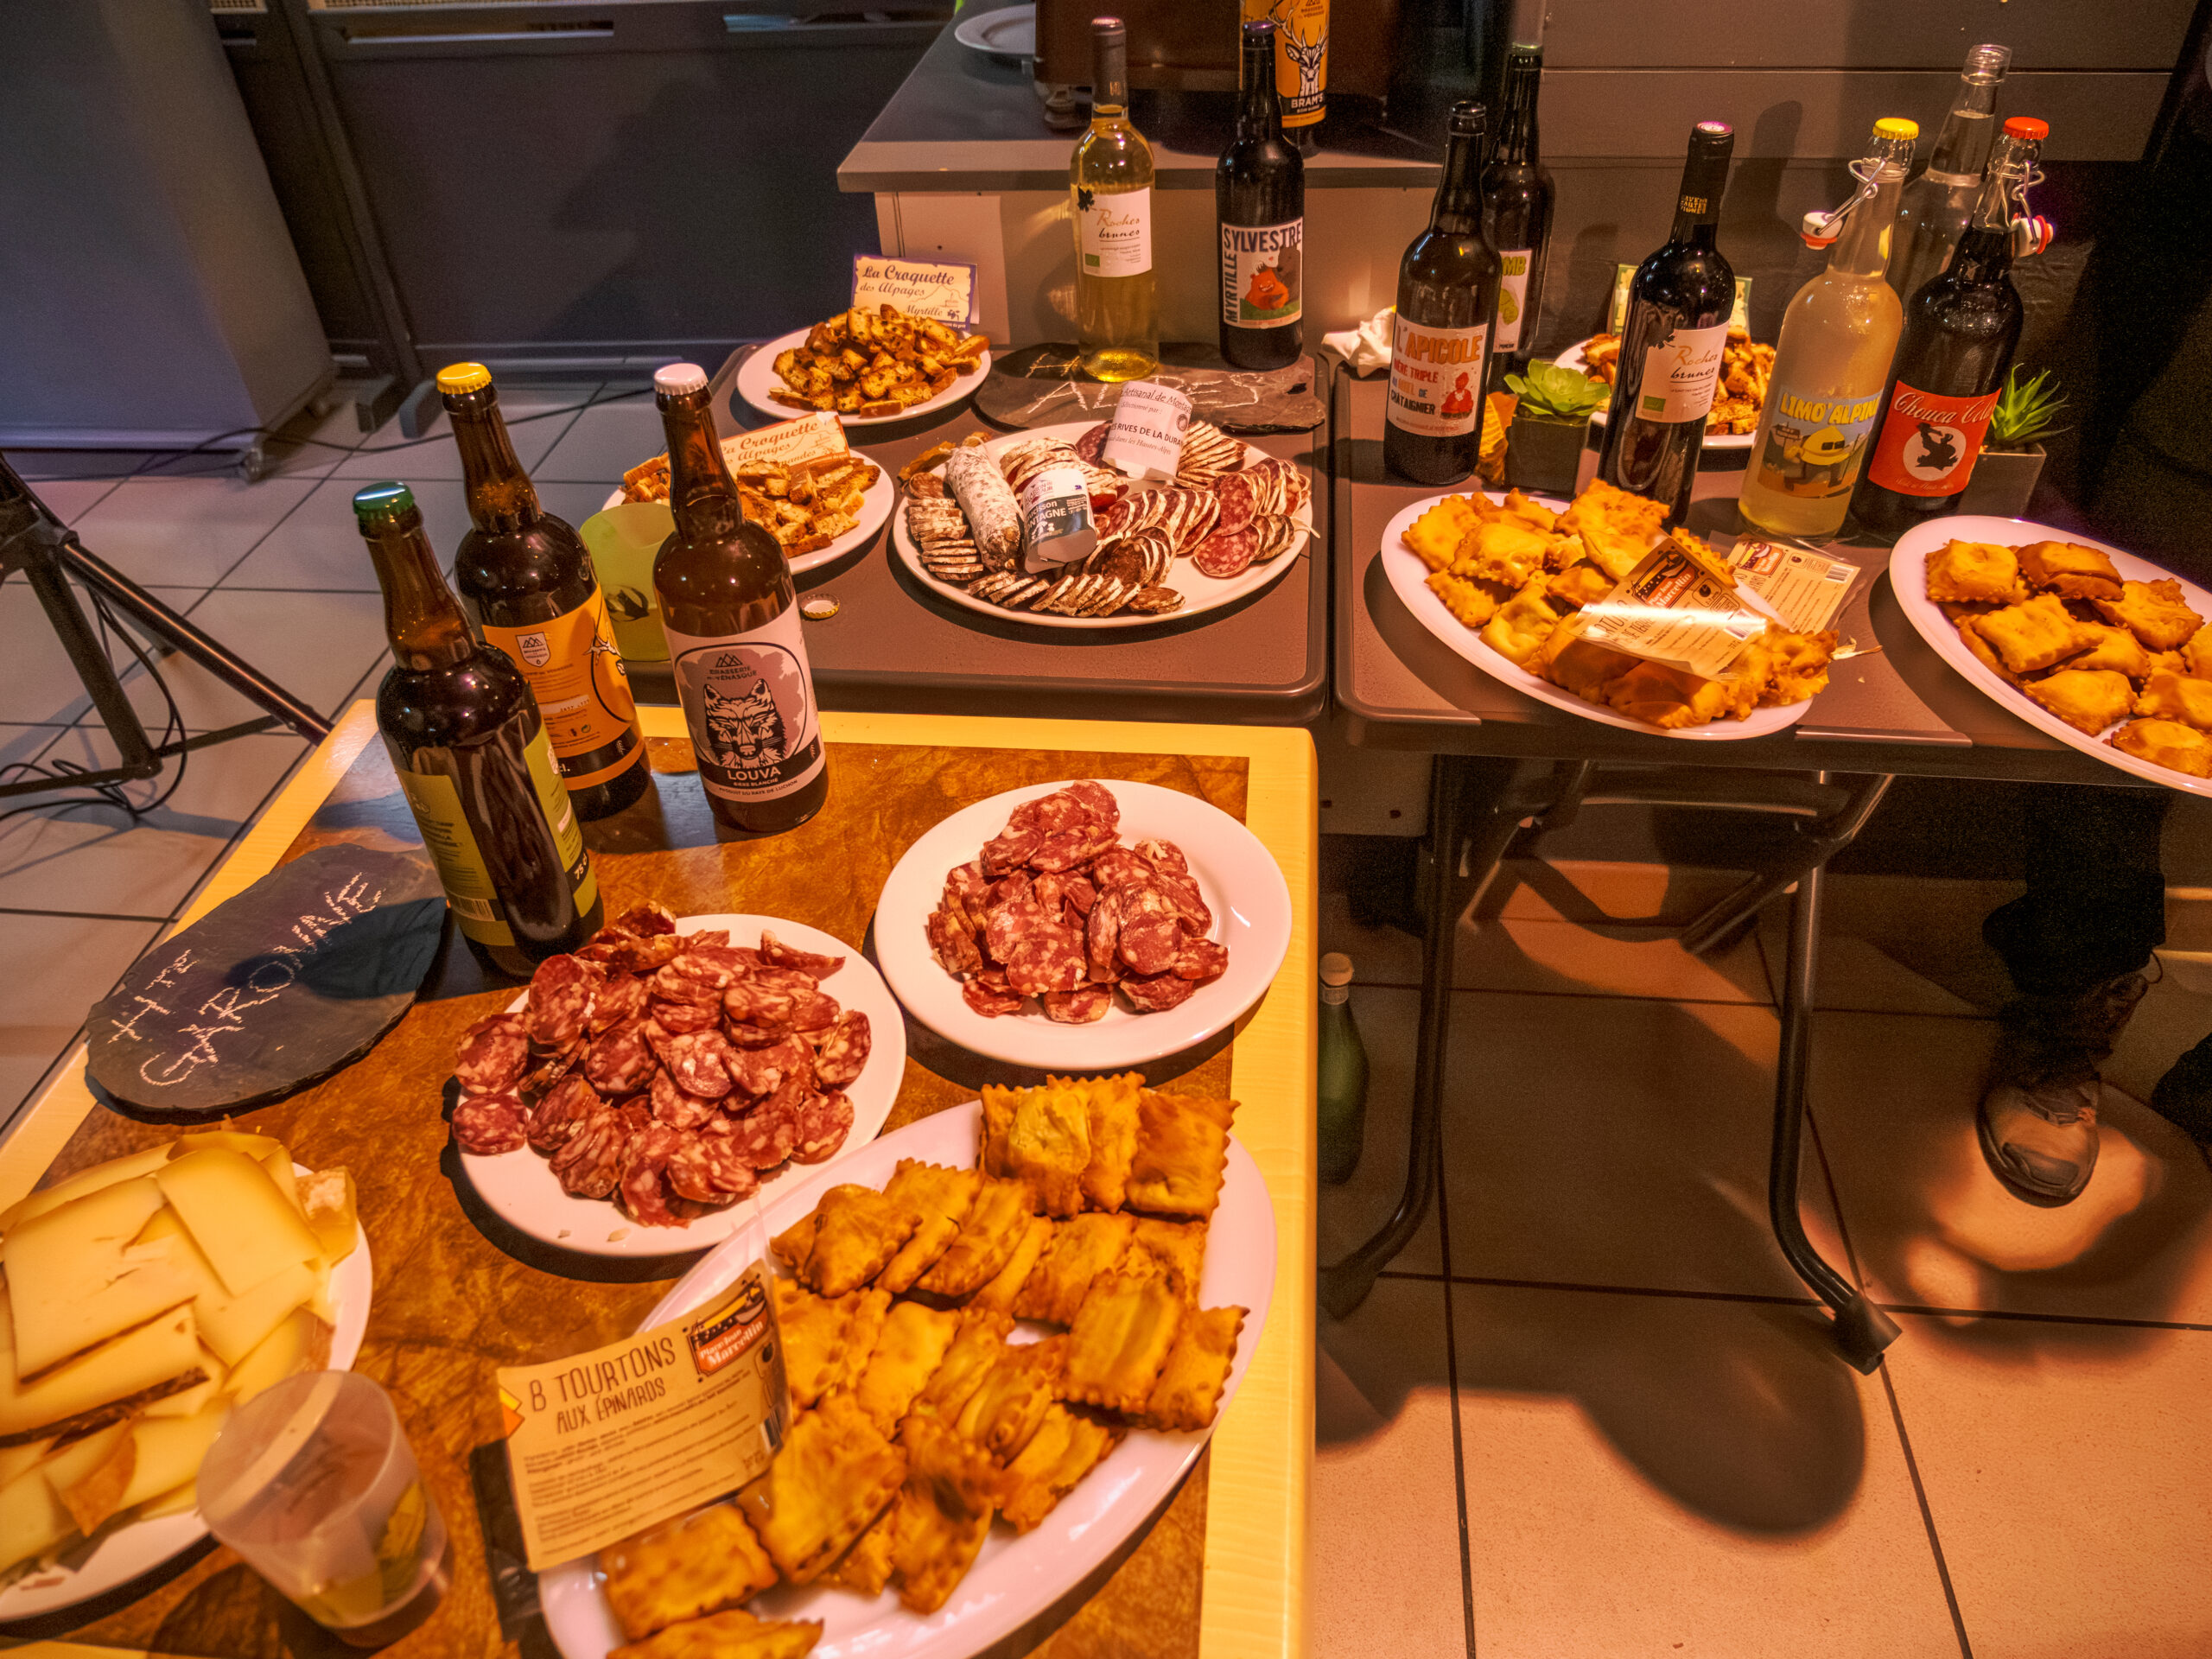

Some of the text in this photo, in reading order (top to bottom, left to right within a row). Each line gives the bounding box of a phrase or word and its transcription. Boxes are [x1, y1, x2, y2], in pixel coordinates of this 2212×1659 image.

[1291, 92, 1325, 108] BRAM'S
[1224, 222, 1302, 252] SYLVESTRE
[862, 264, 955, 286] La Croquette
[860, 282, 925, 299] des Alpages
[1224, 251, 1238, 323] MYRTILLE
[902, 304, 943, 316] Myrtille
[1396, 325, 1483, 365] L'APICOLE
[1410, 366, 1439, 384] TRIPLE
[1155, 392, 1166, 402] de
[1894, 392, 1958, 423] Chouca
[740, 422, 819, 450] Croquette
[1117, 423, 1138, 433] RIVES
[1140, 428, 1151, 436] DE
[1153, 430, 1164, 441] LA
[738, 442, 791, 461] Alpages
[1028, 500, 1058, 518] ucisson
[1028, 508, 1067, 528] NTAGNE
[728, 766, 781, 781] LOUVA
[708, 1320, 763, 1365] Marcellin
[529, 1338, 676, 1413] 8 TOURTONS
[556, 1376, 667, 1434] AUX ÉPINARDS
